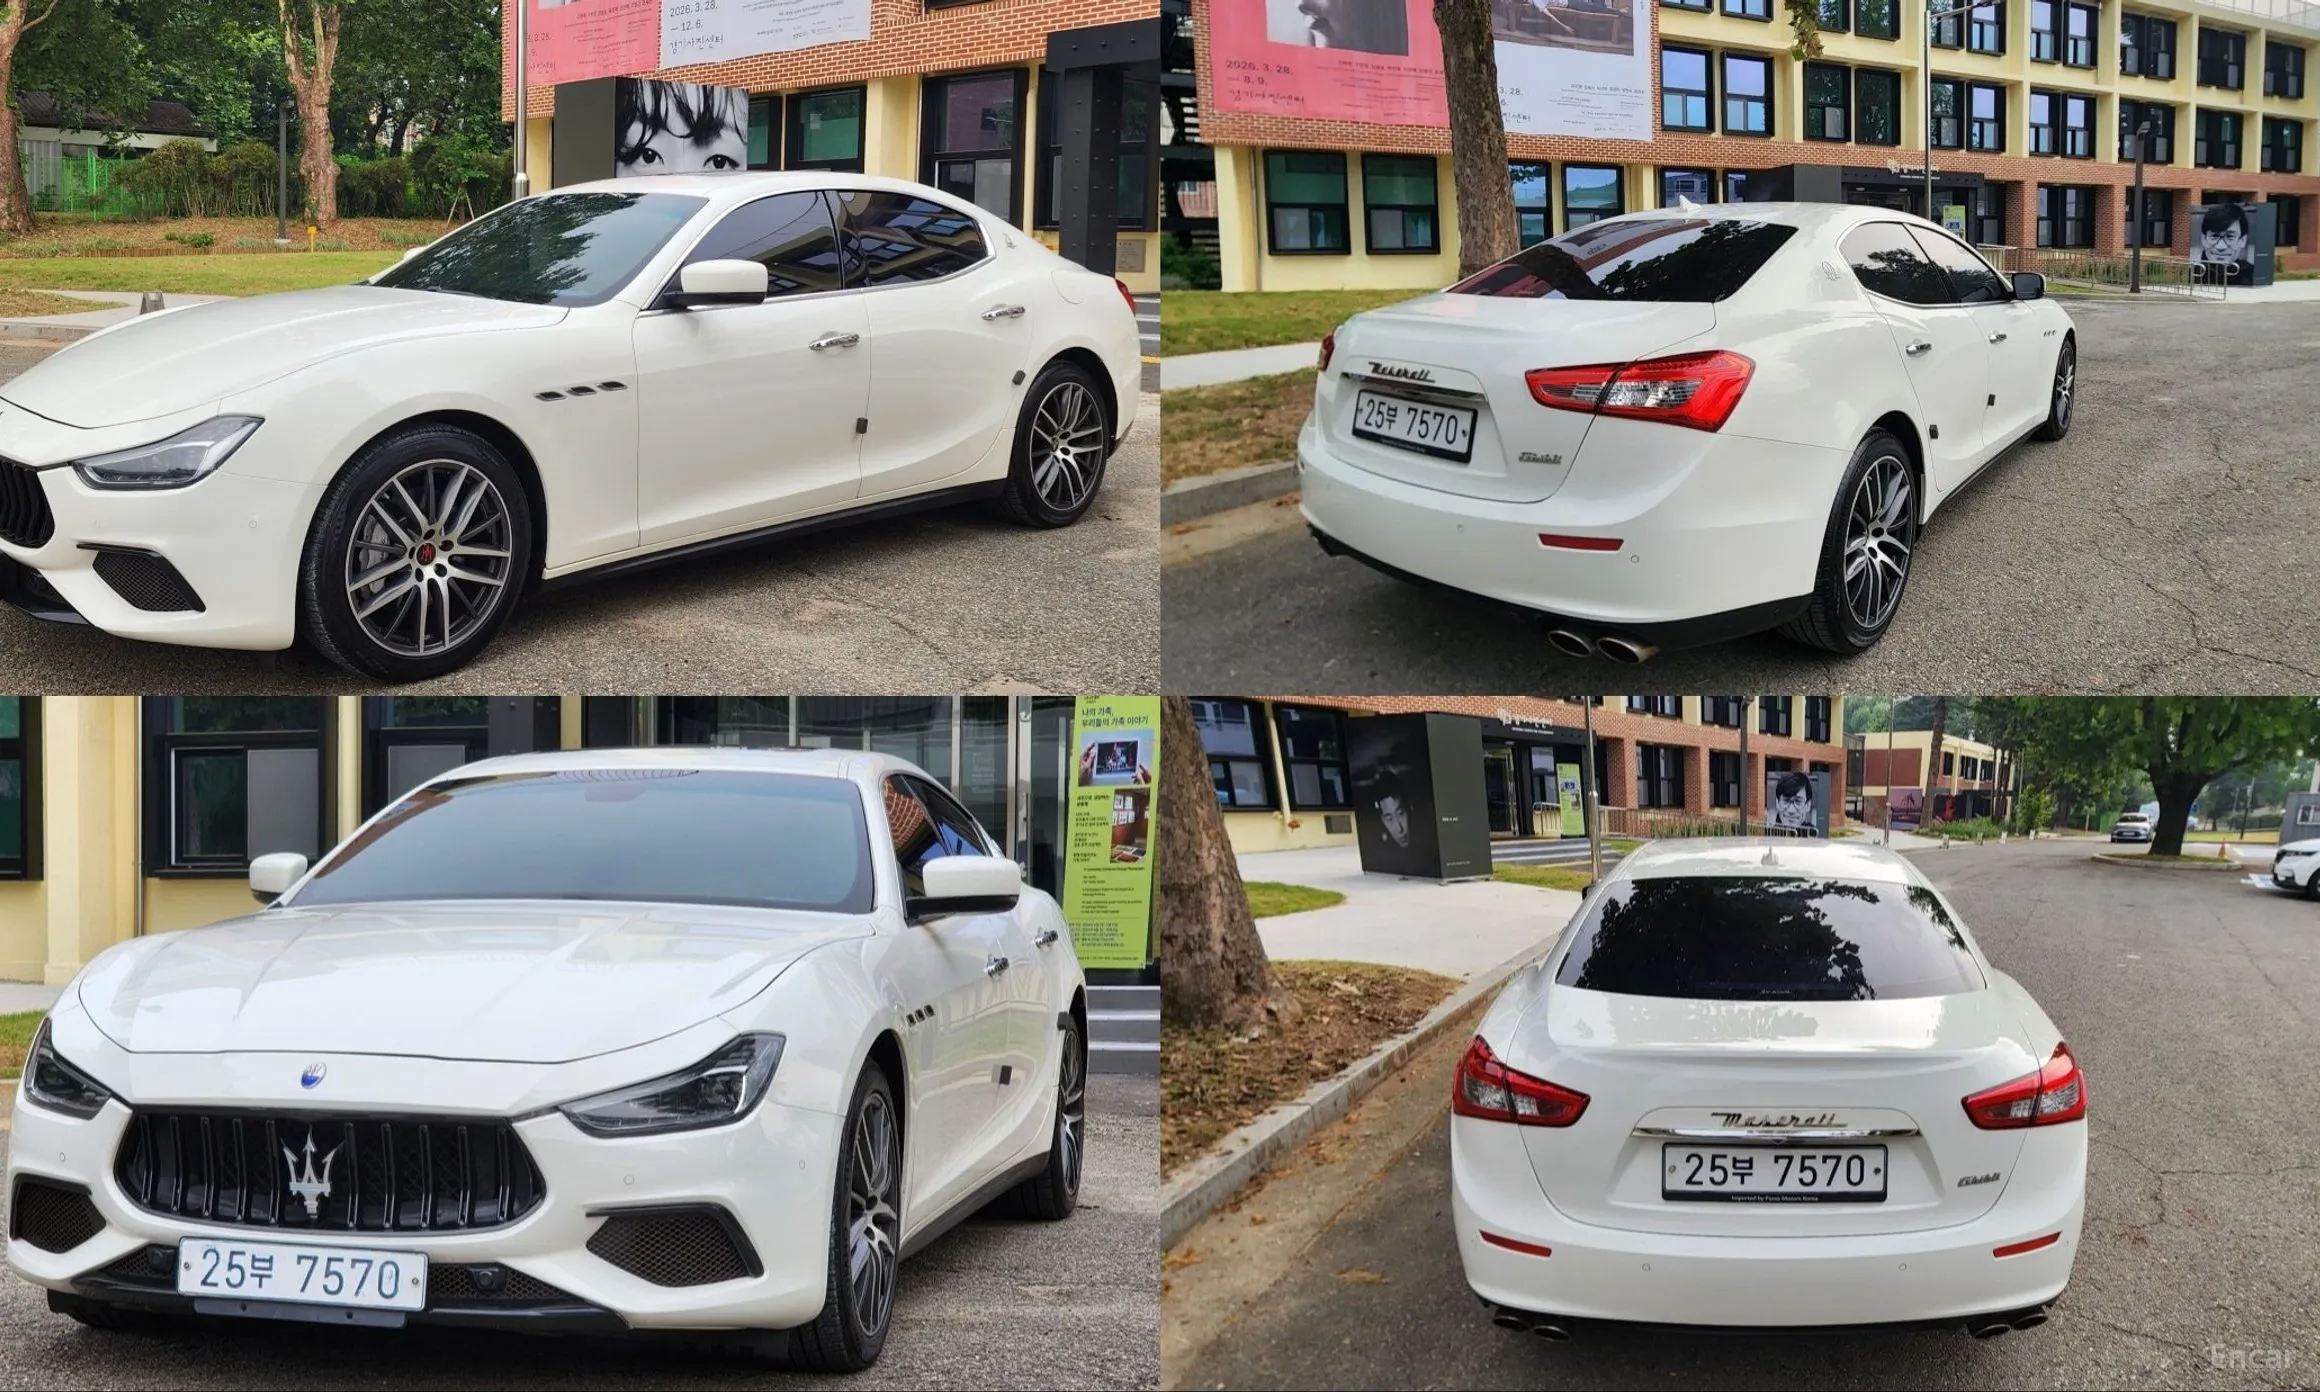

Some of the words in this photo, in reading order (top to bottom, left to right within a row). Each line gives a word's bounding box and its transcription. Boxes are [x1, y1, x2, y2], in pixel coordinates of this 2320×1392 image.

[670, 4, 693, 17] 2026.
[694, 2, 702, 12] 3.
[704, 0, 718, 11] 28.
[695, 19, 703, 29] 6.
[669, 33, 724, 55] 경기사진센터
[1225, 59, 1260, 71] 2026.
[1276, 64, 1294, 75] 28.
[1228, 89, 1305, 106] 경기사진센터
[1509, 87, 1523, 96] 28.
[1364, 399, 1398, 431] 25부
[1406, 407, 1459, 445] 7570
[1082, 707, 1096, 717] 나의
[1110, 716, 1125, 727] 가족
[1127, 715, 1149, 726] 이야기
[1710, 1112, 1848, 1128] Maserati
[1685, 1153, 1754, 1187] 25부
[1774, 1154, 1865, 1187] 7570
[200, 1248, 274, 1289] 25부
[296, 1254, 400, 1300] 7570
